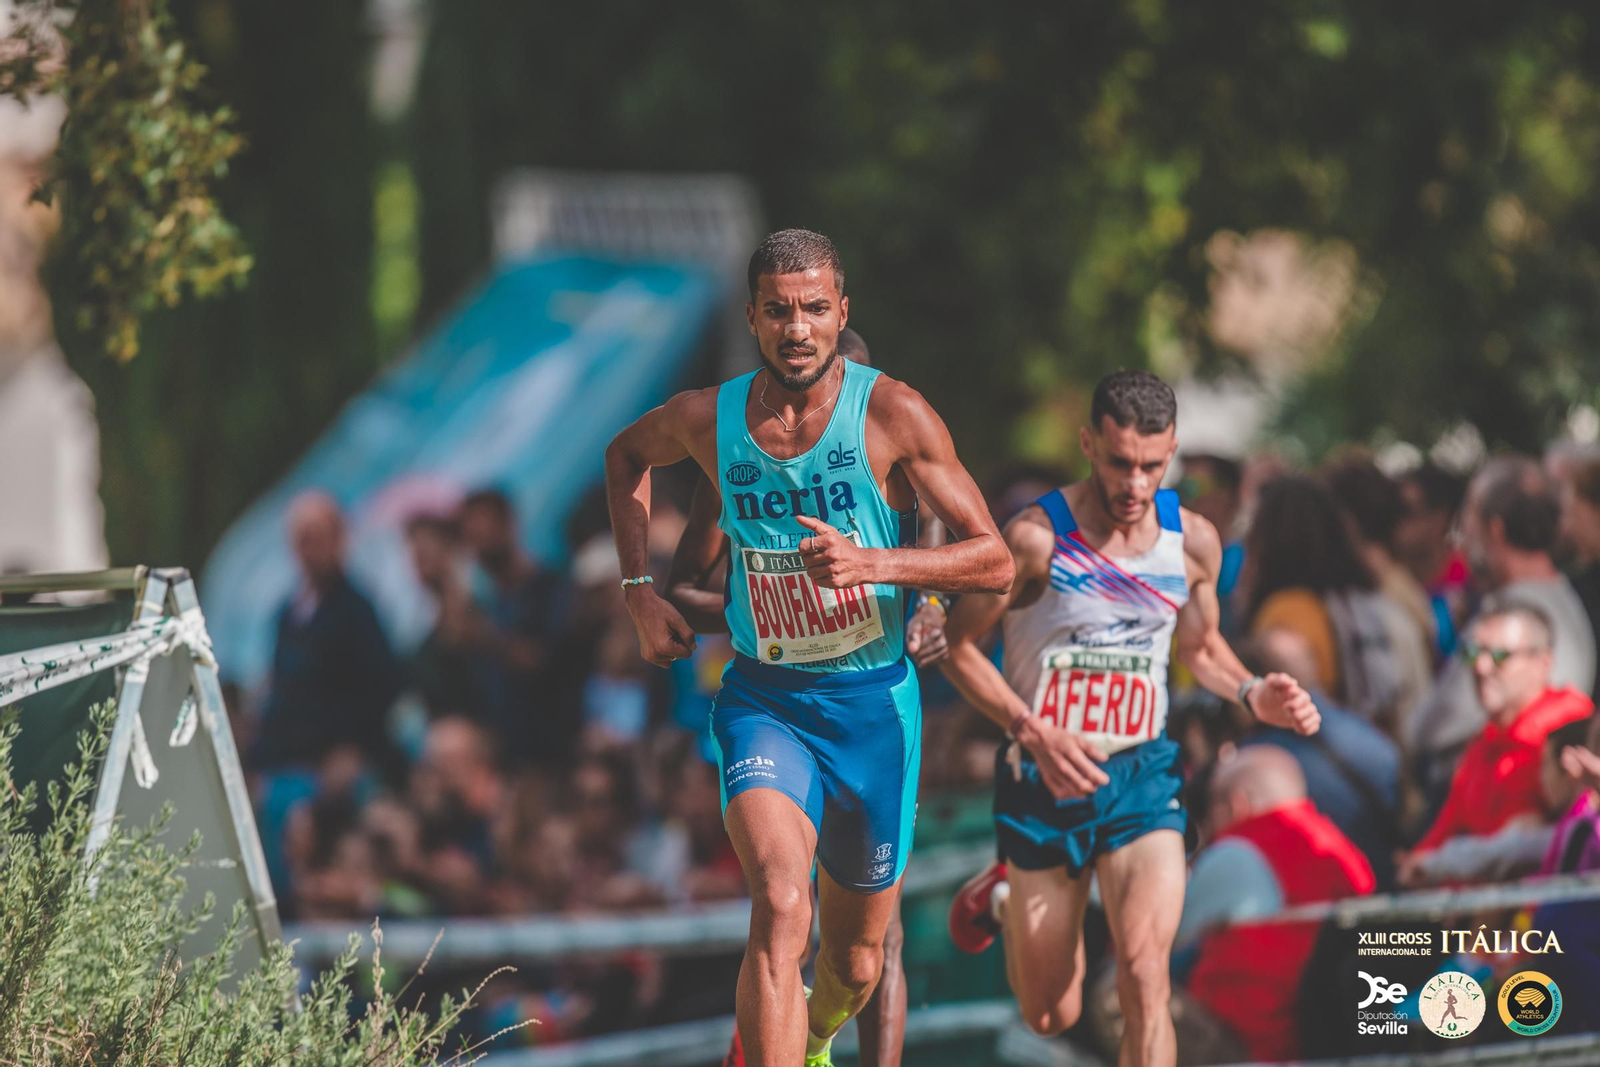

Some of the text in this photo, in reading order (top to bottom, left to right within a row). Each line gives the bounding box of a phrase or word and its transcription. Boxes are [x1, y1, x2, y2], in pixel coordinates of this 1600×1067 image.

[728, 465, 760, 482] TROPS
[732, 473, 858, 523] nerja
[769, 554, 805, 570] ITÁLI
[1039, 668, 1157, 741] AFERDI
[727, 755, 775, 775] nerja
